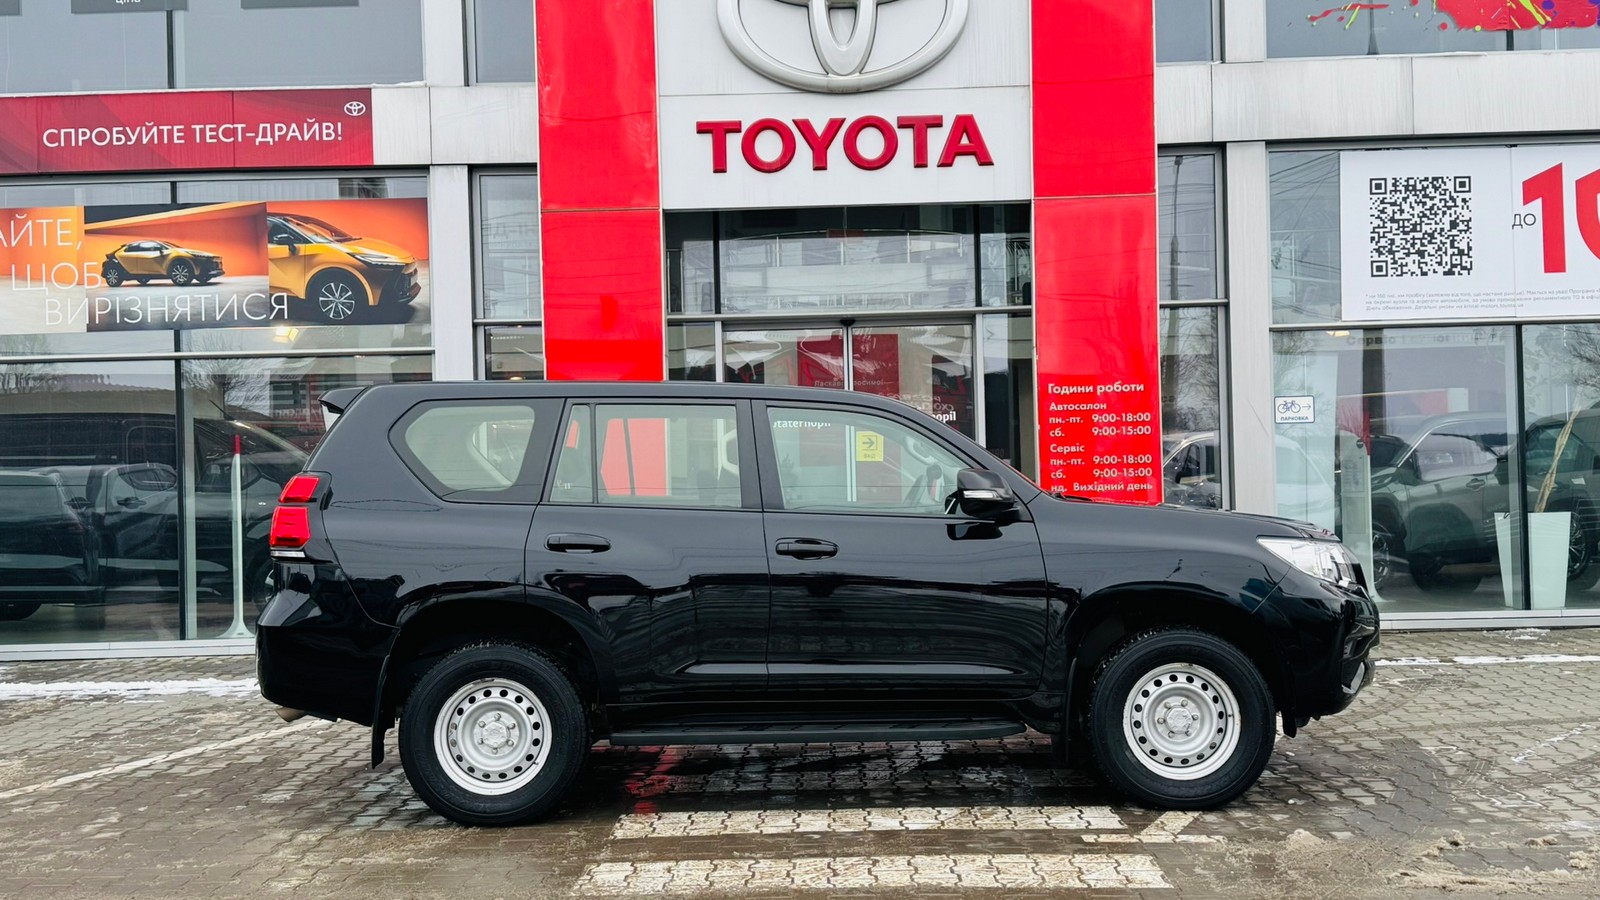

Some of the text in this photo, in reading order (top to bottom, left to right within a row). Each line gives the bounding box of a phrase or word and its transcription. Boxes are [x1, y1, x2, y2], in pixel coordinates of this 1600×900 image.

[42, 118, 343, 147] СПРОБУЙТЕ ТЕСТ-ДРАЙВ!
[696, 114, 994, 173] TOYOTA
[11, 262, 102, 295] ЩОБ
[45, 292, 288, 325] ВИРІЗНЯТИСЯ
[1047, 380, 1145, 396] Години роботи
[1049, 401, 1107, 411] Автосалон
[1049, 412, 1151, 424] пн.-пт. 9:00-18:00
[1049, 425, 1152, 437] сб. 9:00-15:00
[1050, 442, 1085, 455] Сервіс
[1092, 454, 1152, 465] 9:00-18:00
[1050, 467, 1153, 479] сб. 9:00-15:00
[1051, 481, 1153, 493] нд. Вихідний день
